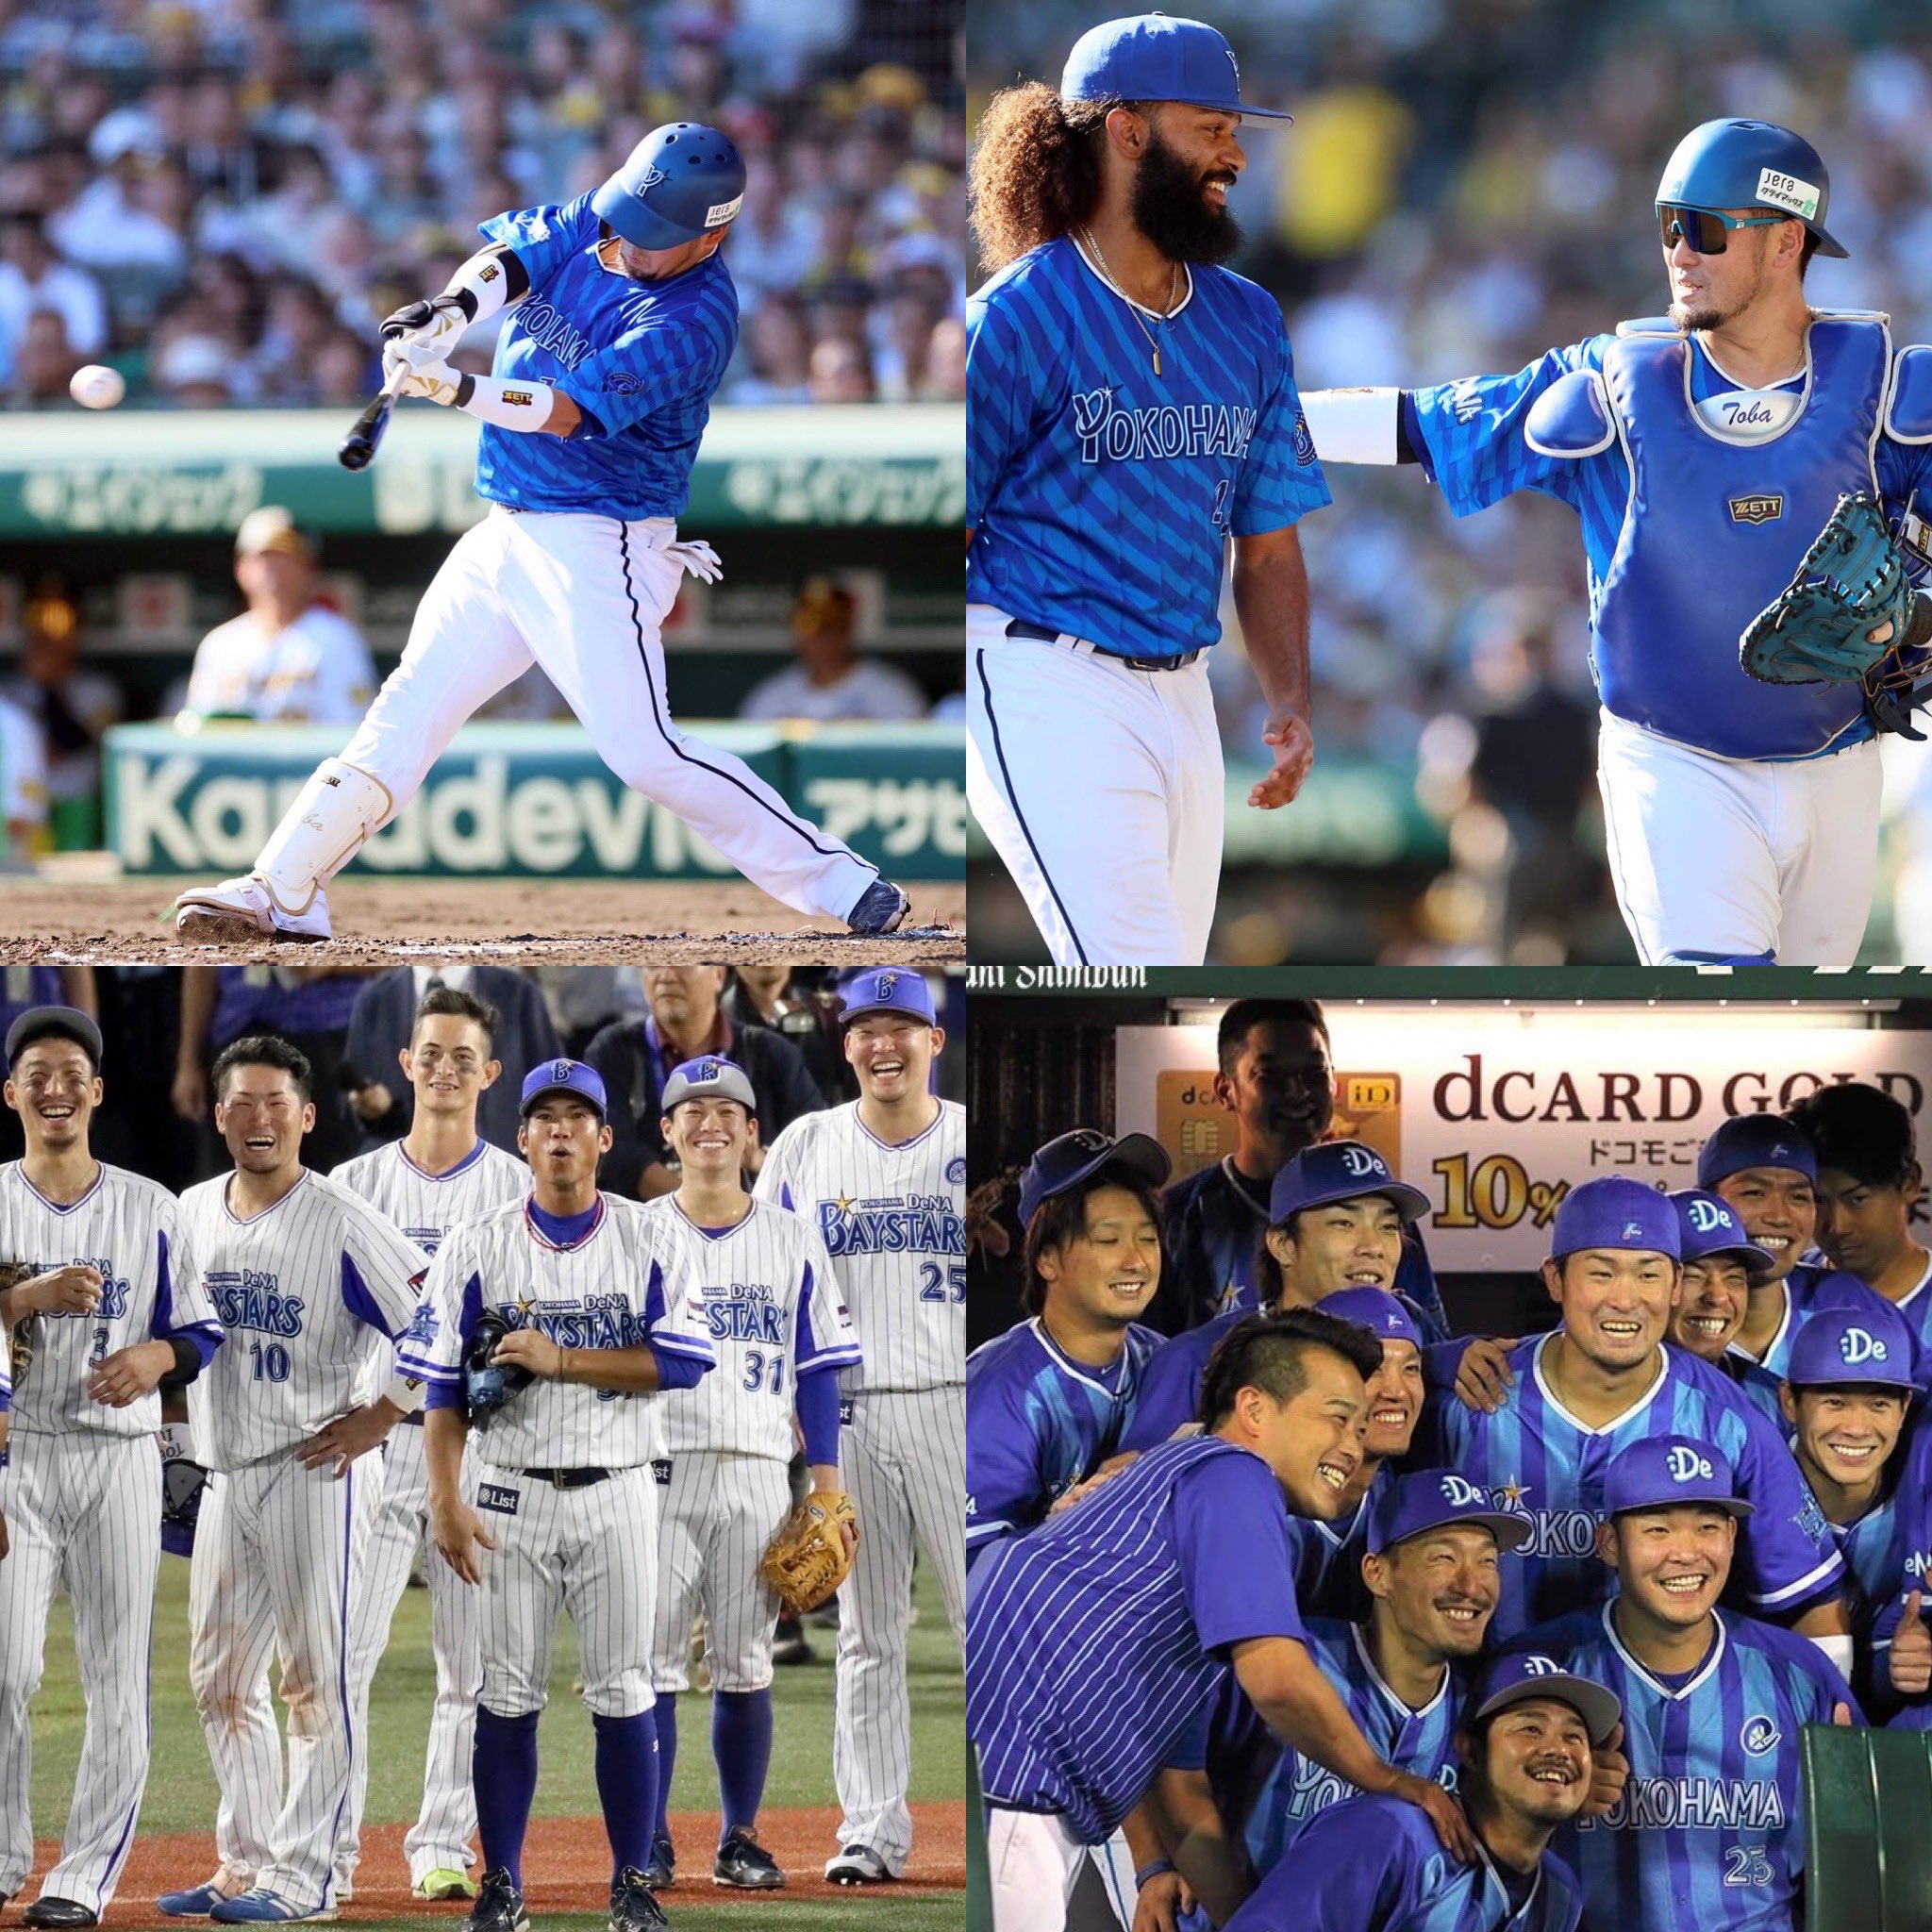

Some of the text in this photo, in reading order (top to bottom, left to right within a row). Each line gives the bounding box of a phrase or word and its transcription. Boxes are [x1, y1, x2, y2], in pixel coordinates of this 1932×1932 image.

[503, 391, 532, 402] ZETT
[1072, 388, 1257, 463] YOKOHAMA
[1723, 401, 1774, 425] Toba
[1734, 500, 1779, 514] ZETT
[875, 974, 894, 1003] B
[551, 1060, 571, 1083] B
[1591, 1139, 1705, 1166] ドコモご
[859, 1193, 954, 1212] YOKOHAMA DeNA
[243, 1269, 278, 1291] DeNA
[731, 1284, 774, 1302] DeNA
[921, 1261, 966, 1304] 25
[584, 1293, 628, 1311] DeNA
[705, 1300, 787, 1345] STAR
[89, 1327, 109, 1369] 3
[250, 1342, 291, 1383] 10
[743, 1350, 785, 1395] 31
[490, 1491, 516, 1509] List
[1575, 1776, 1785, 1831] OKOHAMA
[1724, 1844, 1776, 1888] 25
